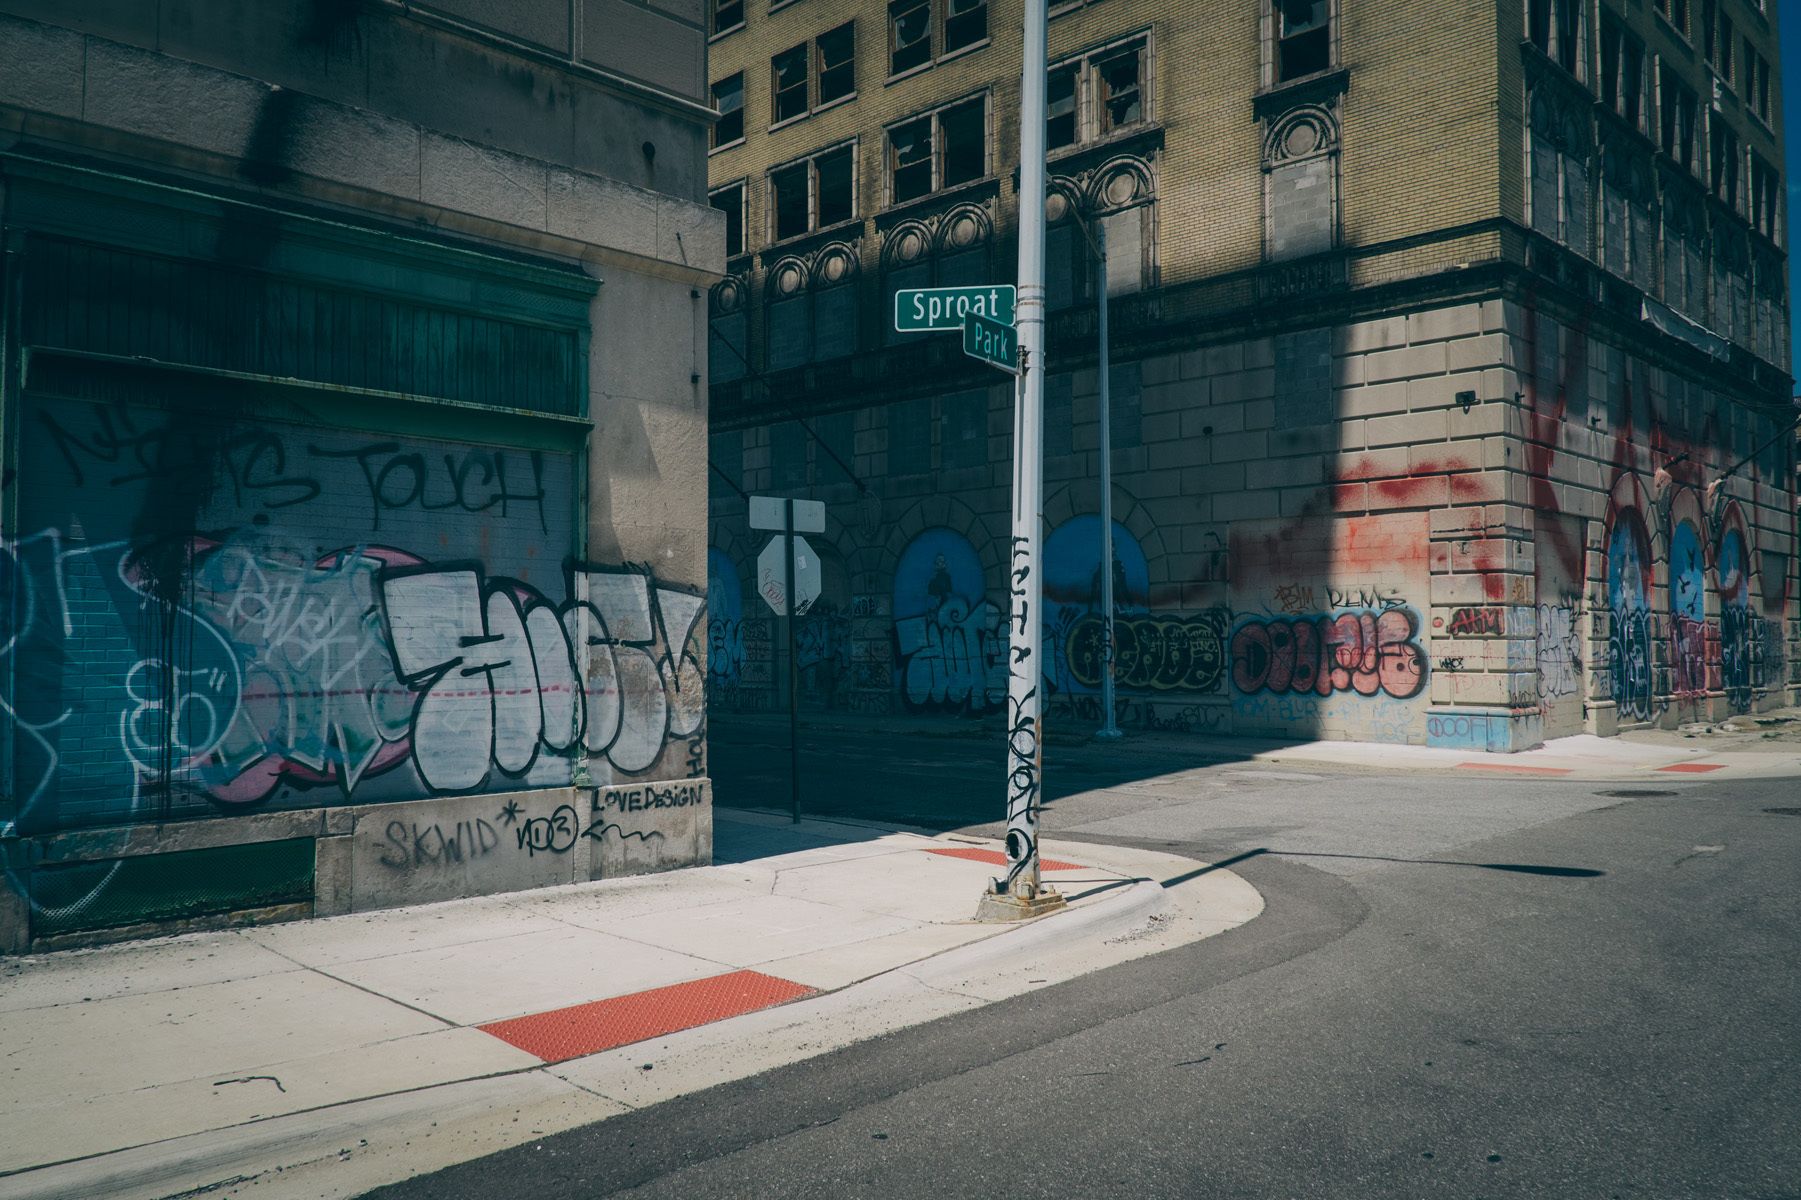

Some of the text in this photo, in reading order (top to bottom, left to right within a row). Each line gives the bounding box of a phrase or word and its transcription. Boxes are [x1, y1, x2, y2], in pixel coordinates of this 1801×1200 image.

[912, 288, 999, 327] Sproat
[974, 321, 1009, 361] Park
[307, 441, 548, 535] TOUCH
[381, 818, 499, 868] SKWID
